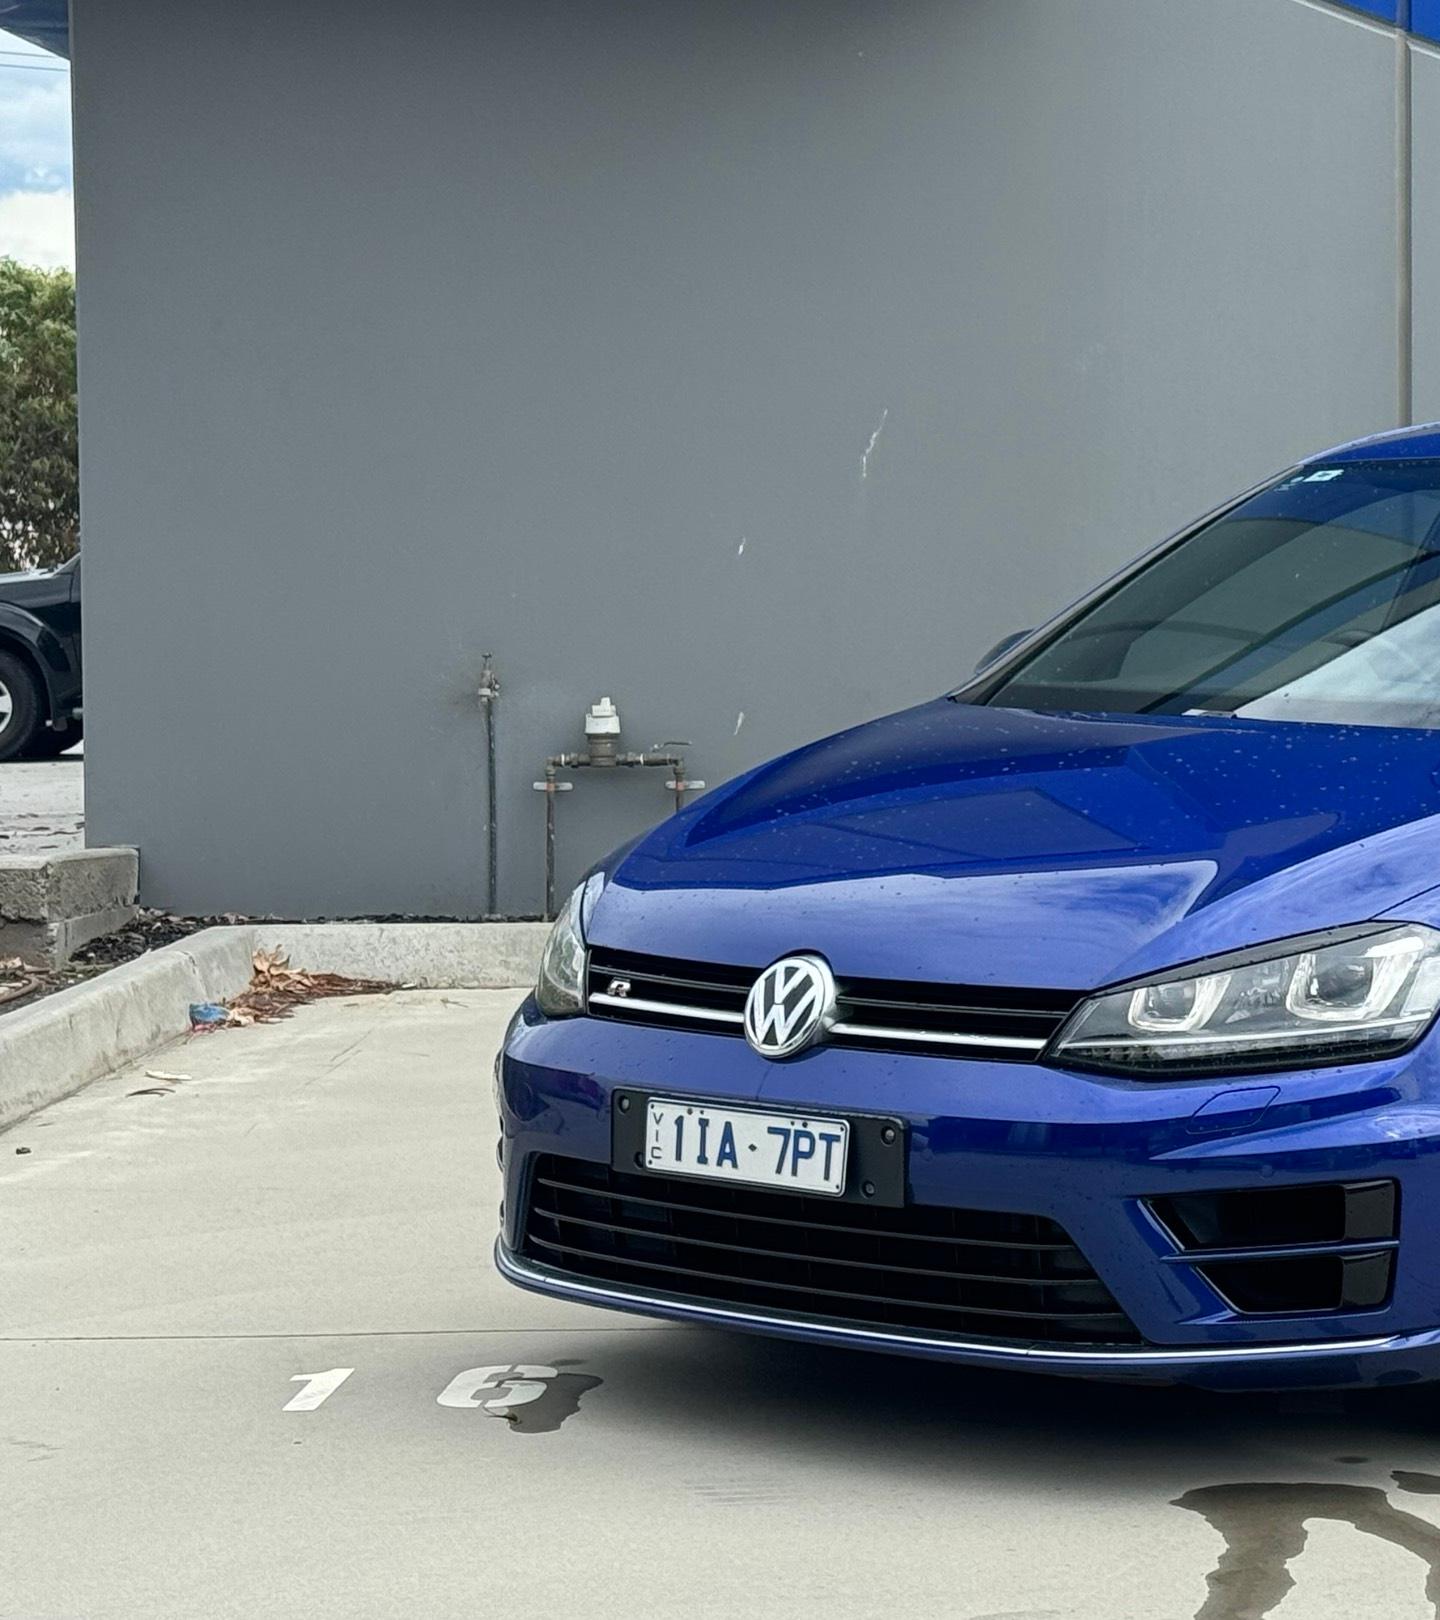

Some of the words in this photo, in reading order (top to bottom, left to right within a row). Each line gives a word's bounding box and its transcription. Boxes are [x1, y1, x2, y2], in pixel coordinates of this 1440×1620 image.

[608, 979, 631, 998] R
[747, 957, 826, 1054] VW
[650, 1112, 664, 1160] VIC
